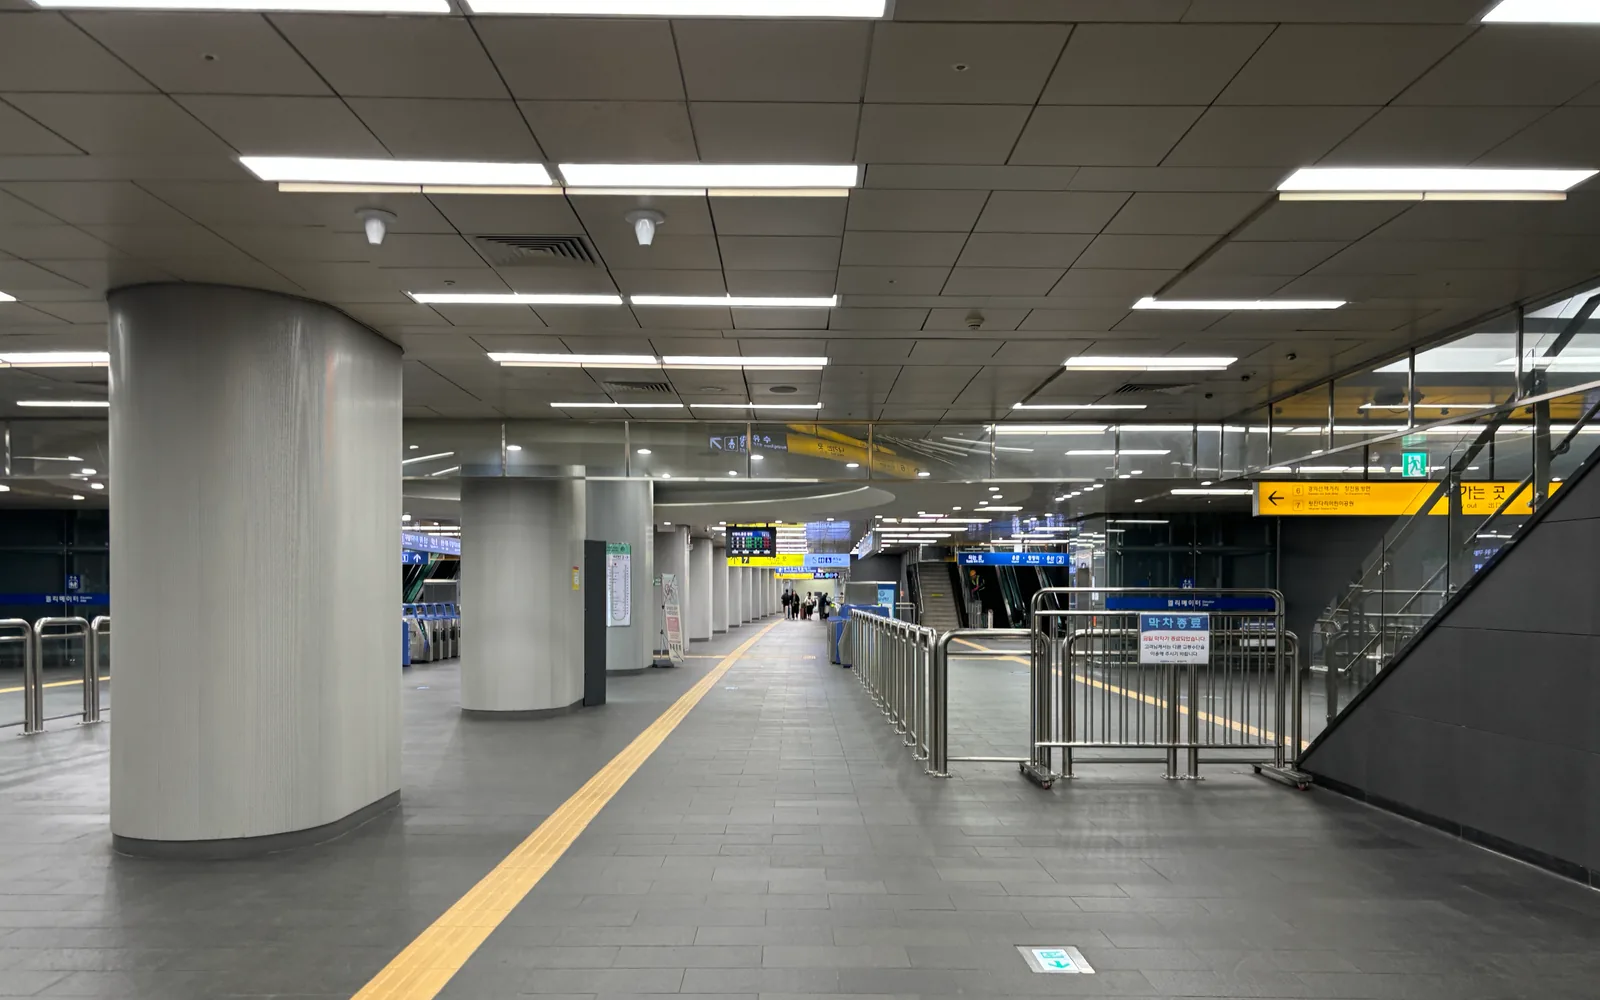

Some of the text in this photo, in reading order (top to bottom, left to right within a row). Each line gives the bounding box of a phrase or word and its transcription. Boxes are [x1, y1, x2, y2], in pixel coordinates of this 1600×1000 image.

[1460, 485, 1505, 500] 가는 곳
[1148, 617, 1201, 629] 막차종료
